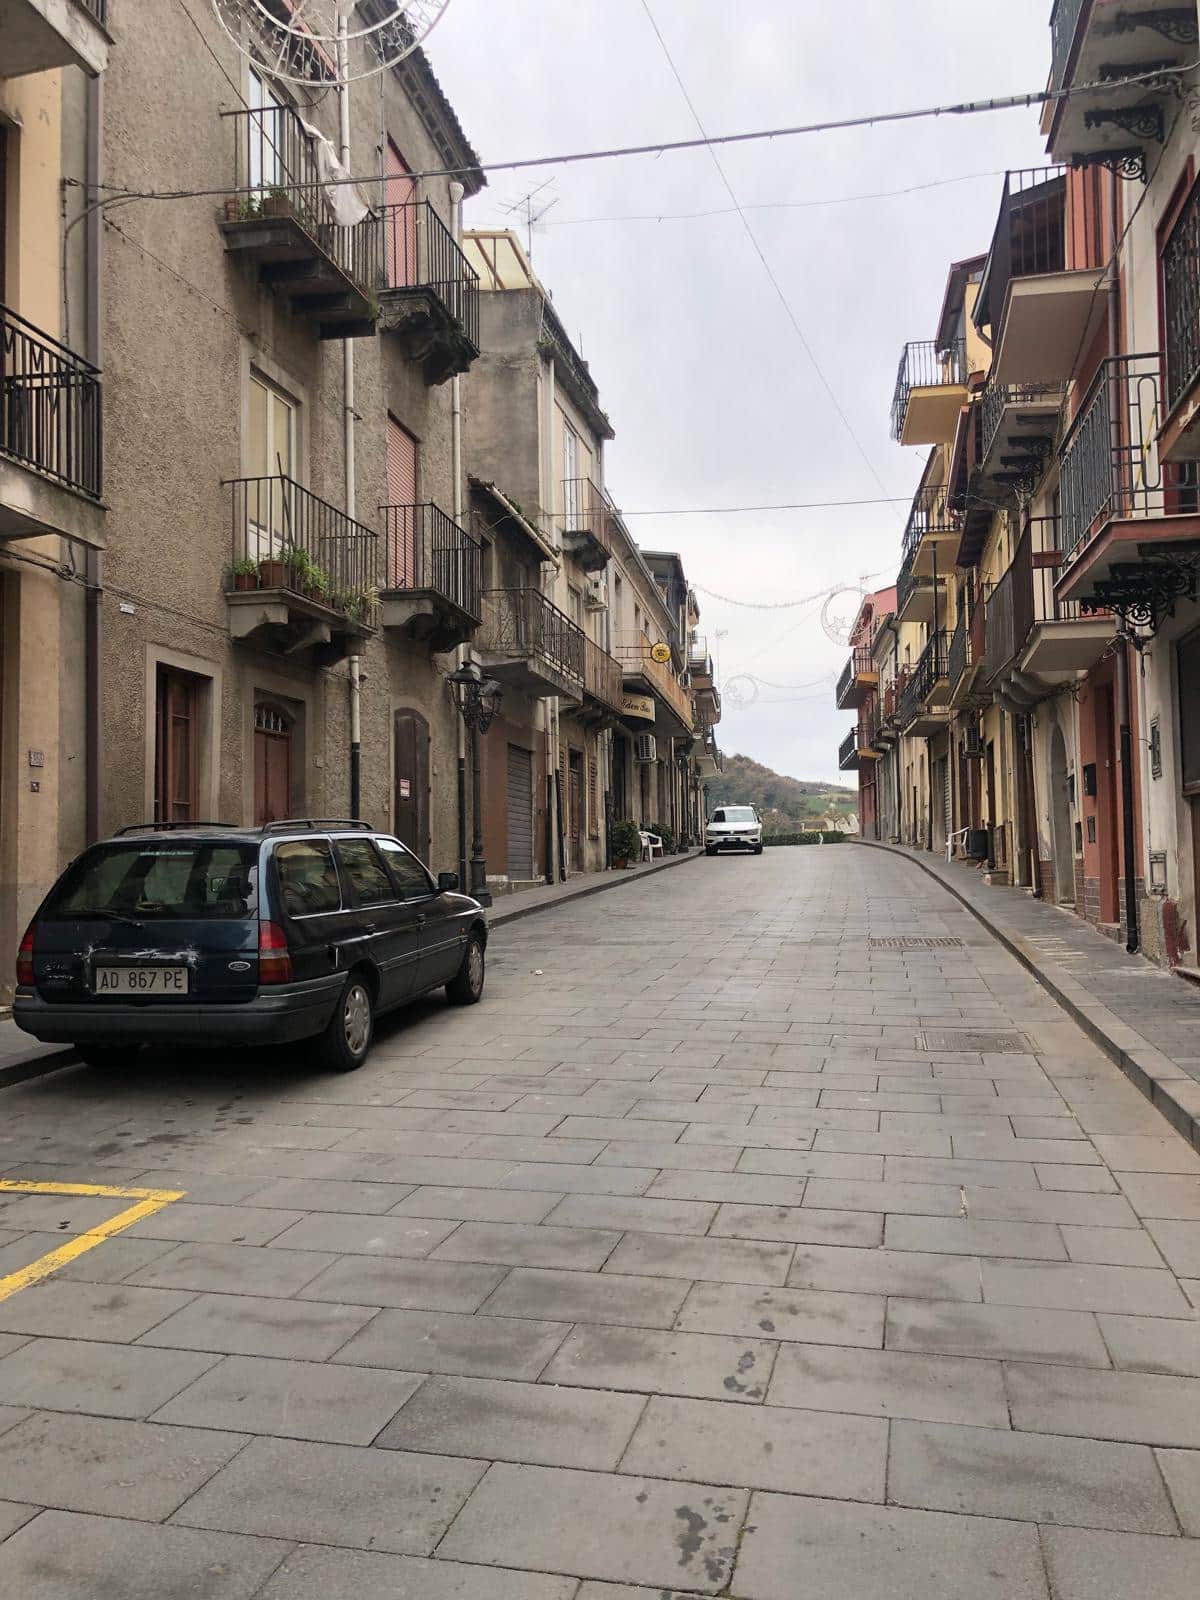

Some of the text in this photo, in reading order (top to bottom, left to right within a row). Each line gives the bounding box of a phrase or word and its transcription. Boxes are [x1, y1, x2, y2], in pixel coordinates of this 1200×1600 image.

[101, 970, 183, 989] AD 867 PE
